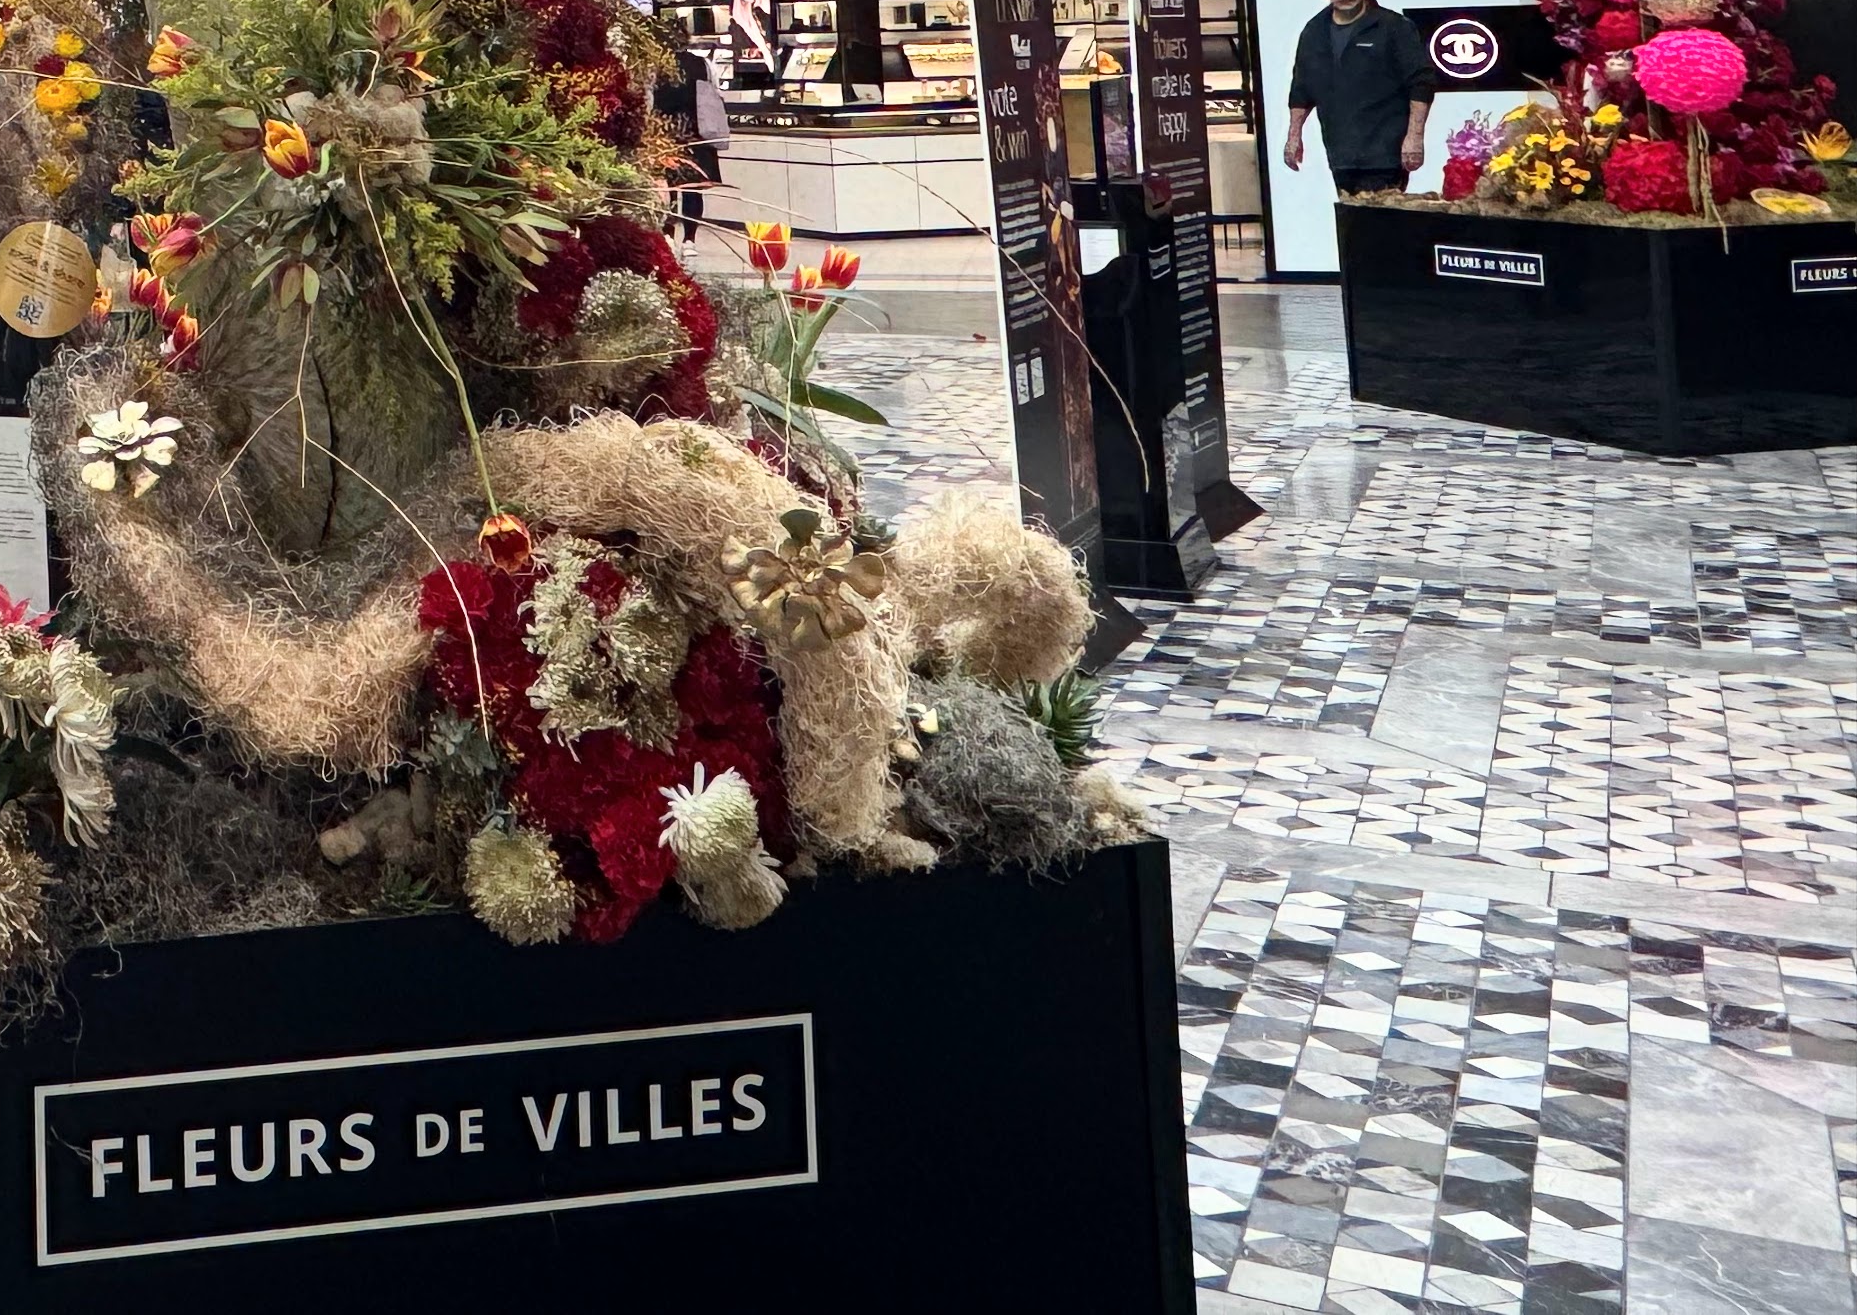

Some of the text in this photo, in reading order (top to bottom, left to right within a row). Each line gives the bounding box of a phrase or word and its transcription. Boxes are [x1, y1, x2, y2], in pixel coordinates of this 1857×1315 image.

[989, 81, 1018, 118] vote
[89, 1071, 769, 1200] FLEURS DE VILLES
